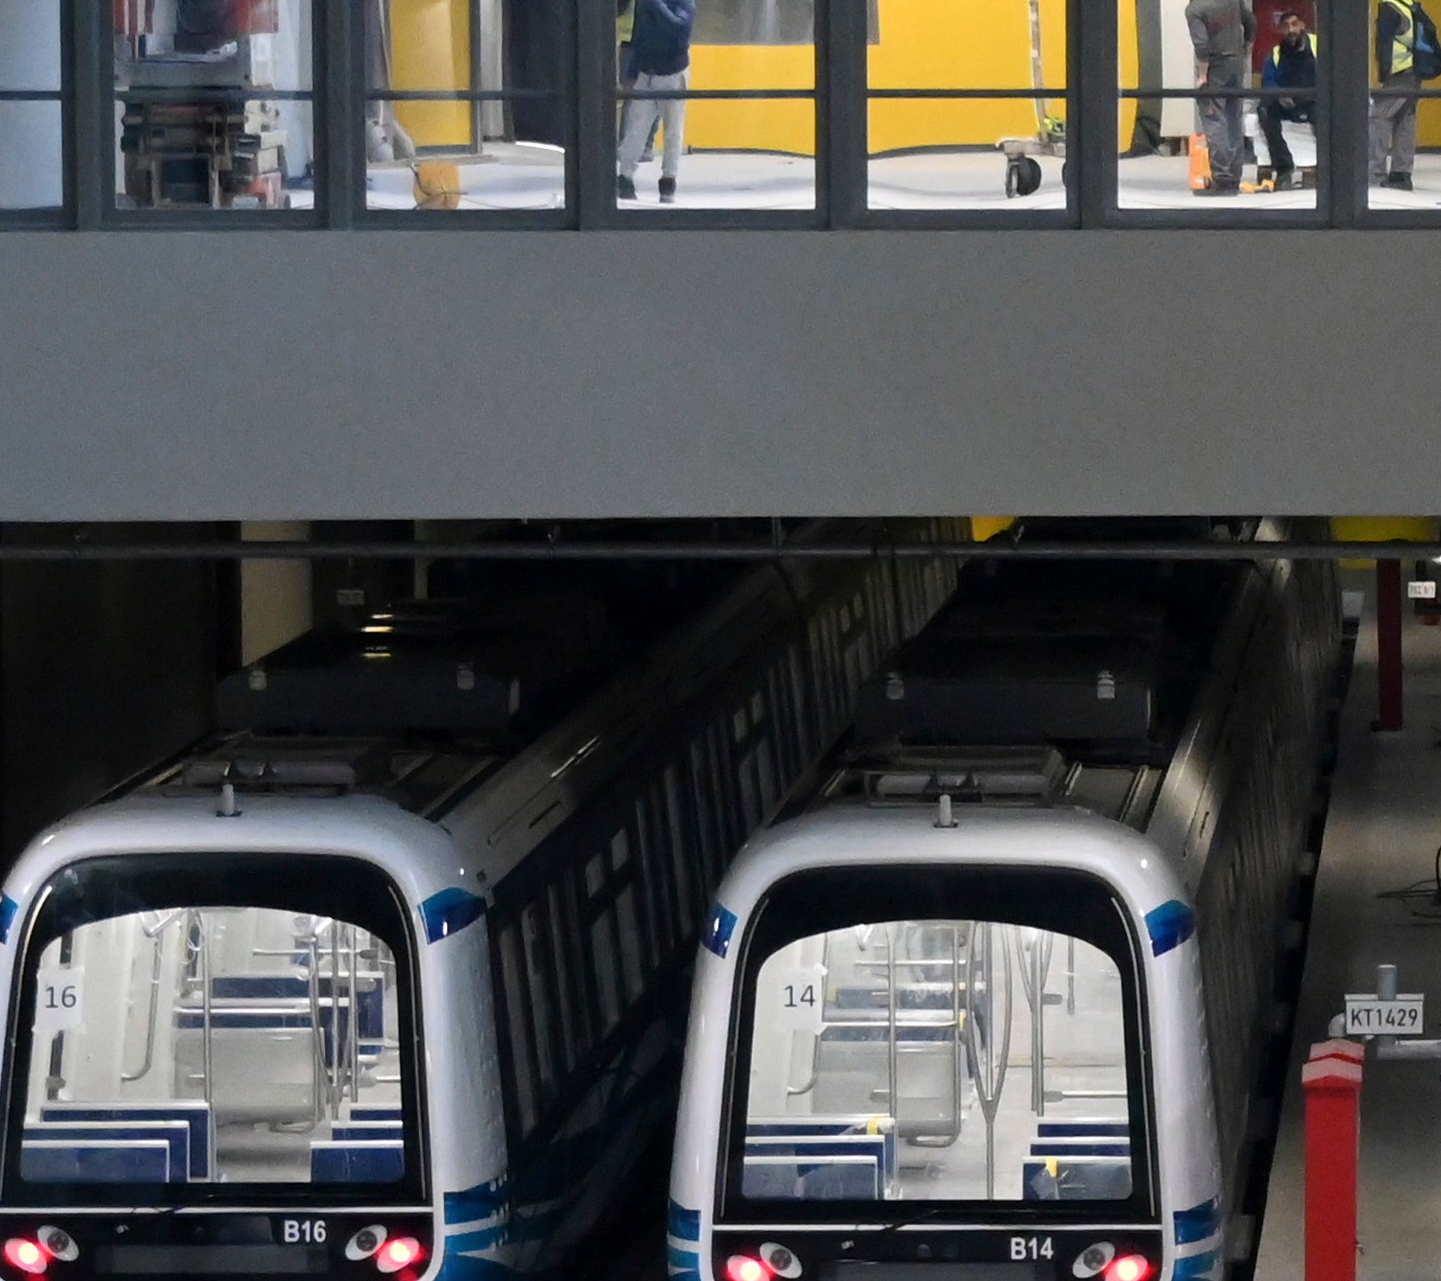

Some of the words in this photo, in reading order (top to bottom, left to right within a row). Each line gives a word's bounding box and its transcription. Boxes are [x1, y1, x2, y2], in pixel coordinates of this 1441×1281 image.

[45, 984, 77, 1009] 16
[784, 984, 816, 1008] 14
[1351, 1008, 1418, 1027] KT1429
[284, 1219, 327, 1243] B16
[1010, 1237, 1054, 1260] B14
